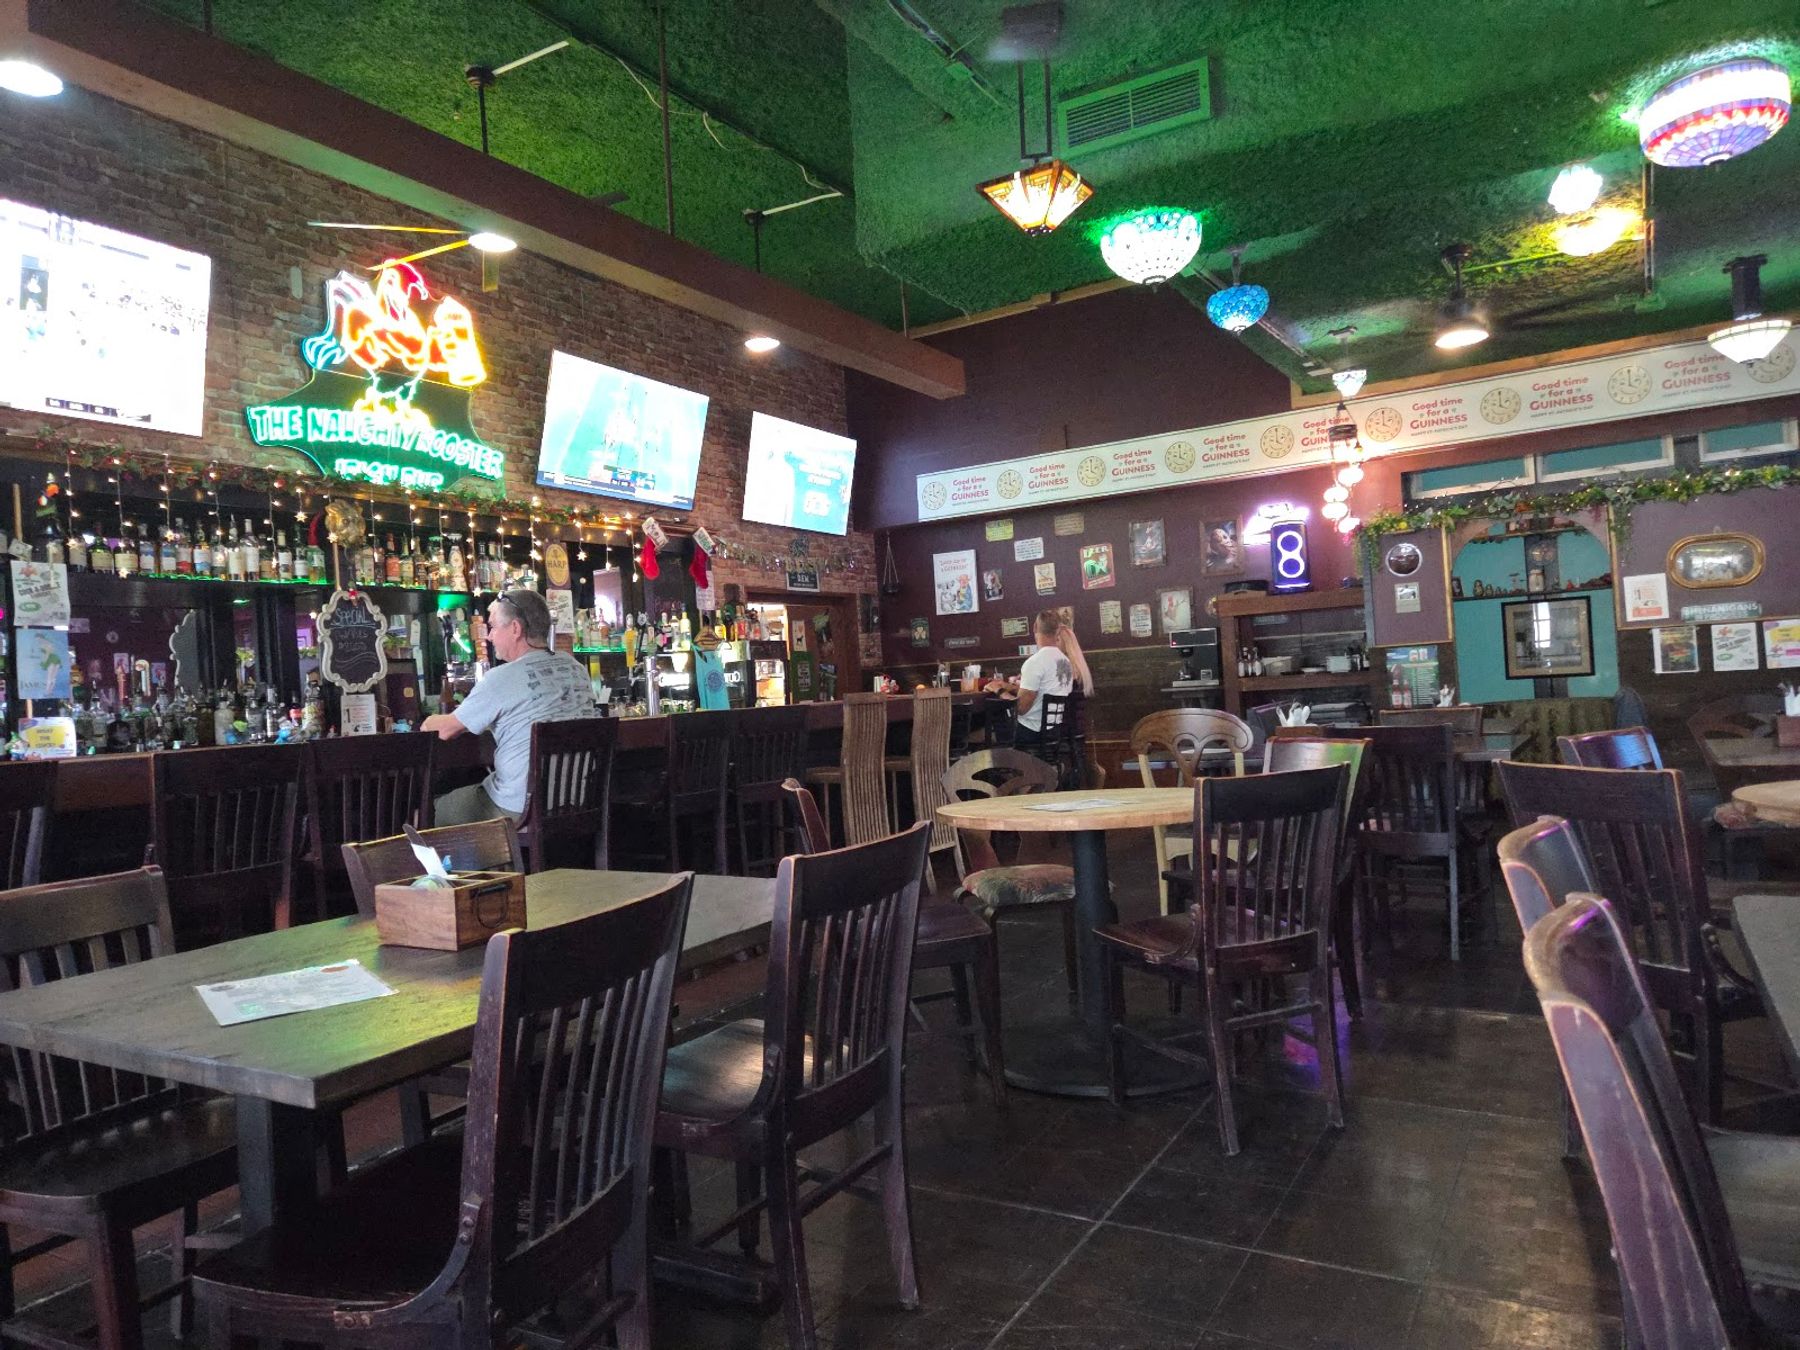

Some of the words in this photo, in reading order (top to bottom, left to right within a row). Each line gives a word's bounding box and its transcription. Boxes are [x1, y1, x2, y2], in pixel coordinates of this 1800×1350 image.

[1664, 358, 1695, 370] Good
[1698, 353, 1726, 365] time
[1682, 366, 1700, 376] for
[1532, 379, 1561, 392] Good
[1563, 375, 1589, 386] time
[1662, 371, 1731, 390] GUINNESS
[1548, 388, 1564, 397] for
[1412, 400, 1438, 411] Good
[1440, 397, 1463, 406] time
[1529, 393, 1594, 411] GUINNESS
[1426, 409, 1441, 417] for
[1303, 418, 1327, 429] Good
[1410, 414, 1468, 429] GUINNESS
[251, 405, 303, 442] THE
[417, 424, 505, 478] ROOSTER
[1203, 435, 1225, 447] Good
[1226, 432, 1247, 442] time
[1215, 443, 1228, 451] for
[1113, 449, 1136, 460] Good
[1137, 448, 1153, 458] time
[1201, 448, 1250, 463] GUINNESS
[1030, 463, 1048, 474] Good
[1048, 462, 1065, 471] time
[1124, 458, 1135, 466] for
[1039, 471, 1050, 479] for
[1111, 463, 1156, 477] GUINNESS
[953, 477, 971, 487] Good
[971, 475, 987, 484] time
[1028, 477, 1069, 490] GUINNESS
[951, 489, 989, 501] GUINNESS
[547, 559, 567, 569] HARP
